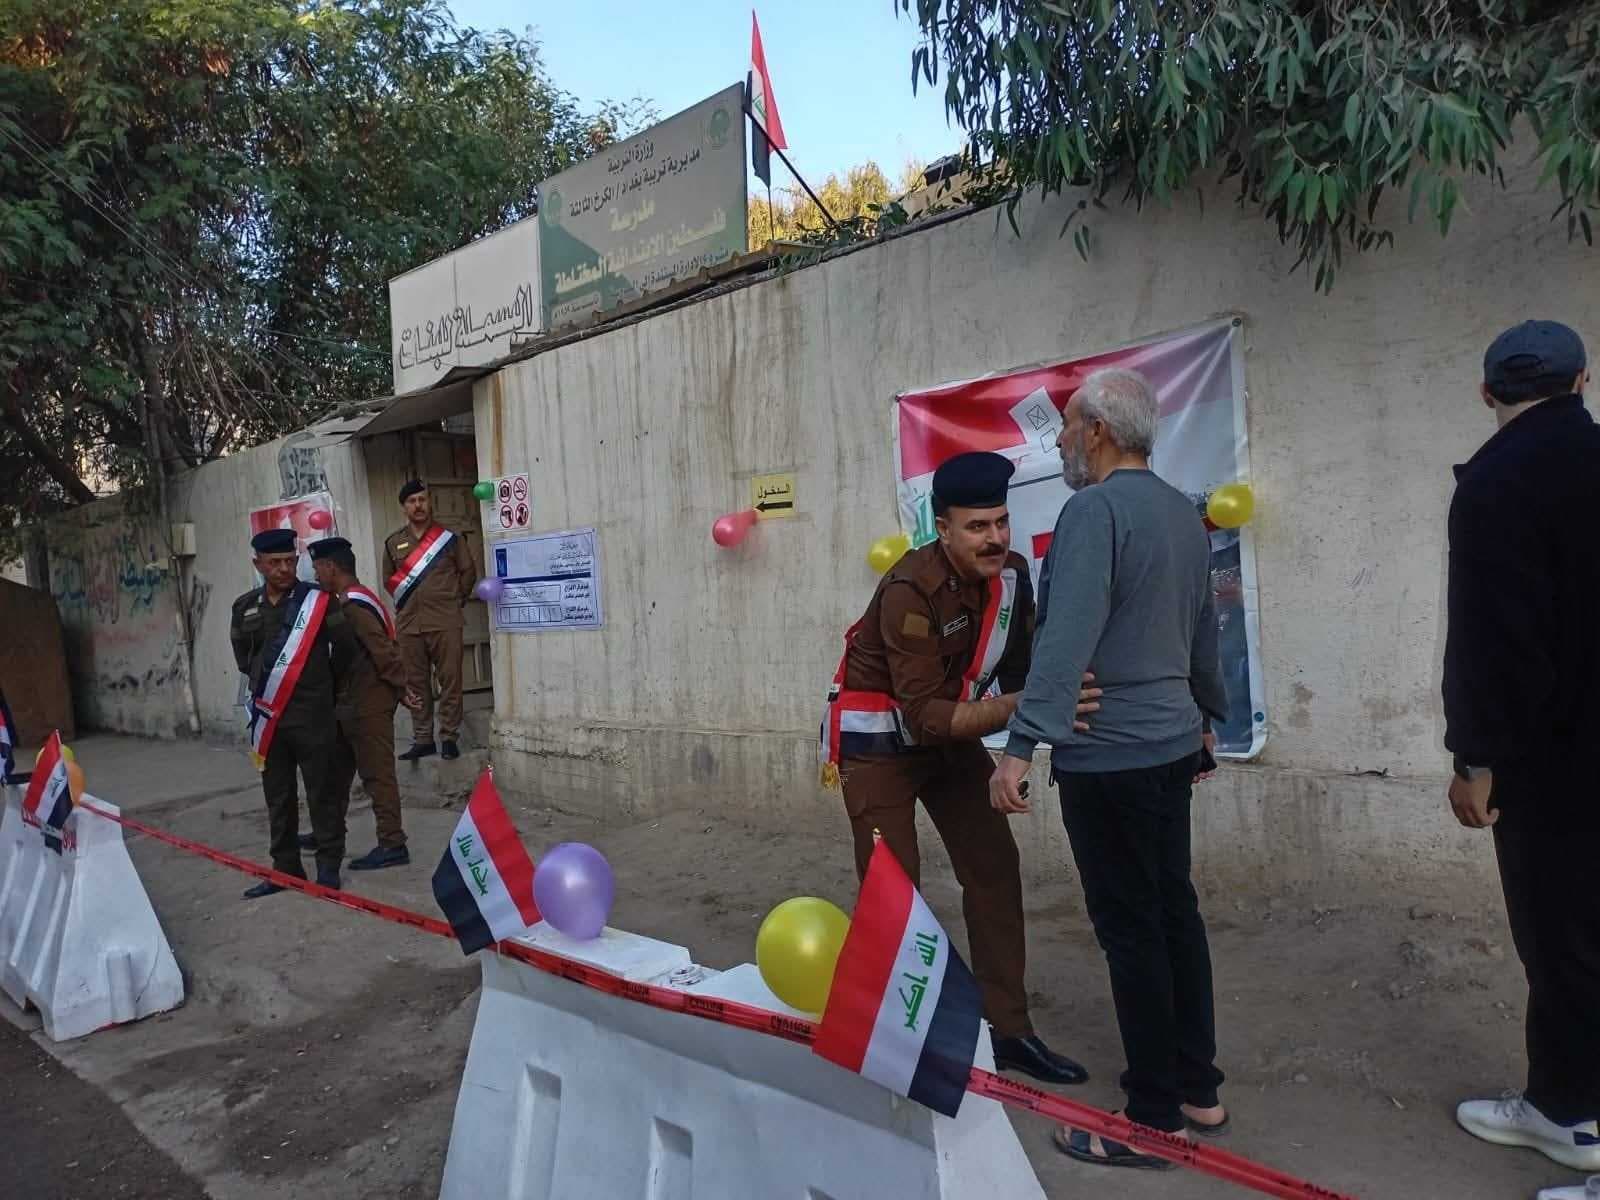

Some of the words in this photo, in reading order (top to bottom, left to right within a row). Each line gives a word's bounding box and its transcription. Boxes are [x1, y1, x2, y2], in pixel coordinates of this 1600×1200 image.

[607, 151, 635, 174] التربية
[634, 139, 654, 163] وزارة
[668, 148, 700, 175] مديرية
[622, 172, 643, 195] بغداد
[643, 159, 667, 186] تربية
[570, 194, 594, 217] الثالثة
[594, 187, 614, 212] الكرخ
[609, 199, 656, 232] مدرسة
[668, 207, 727, 255] فلسطين
[915, 932, 939, 968] الله
